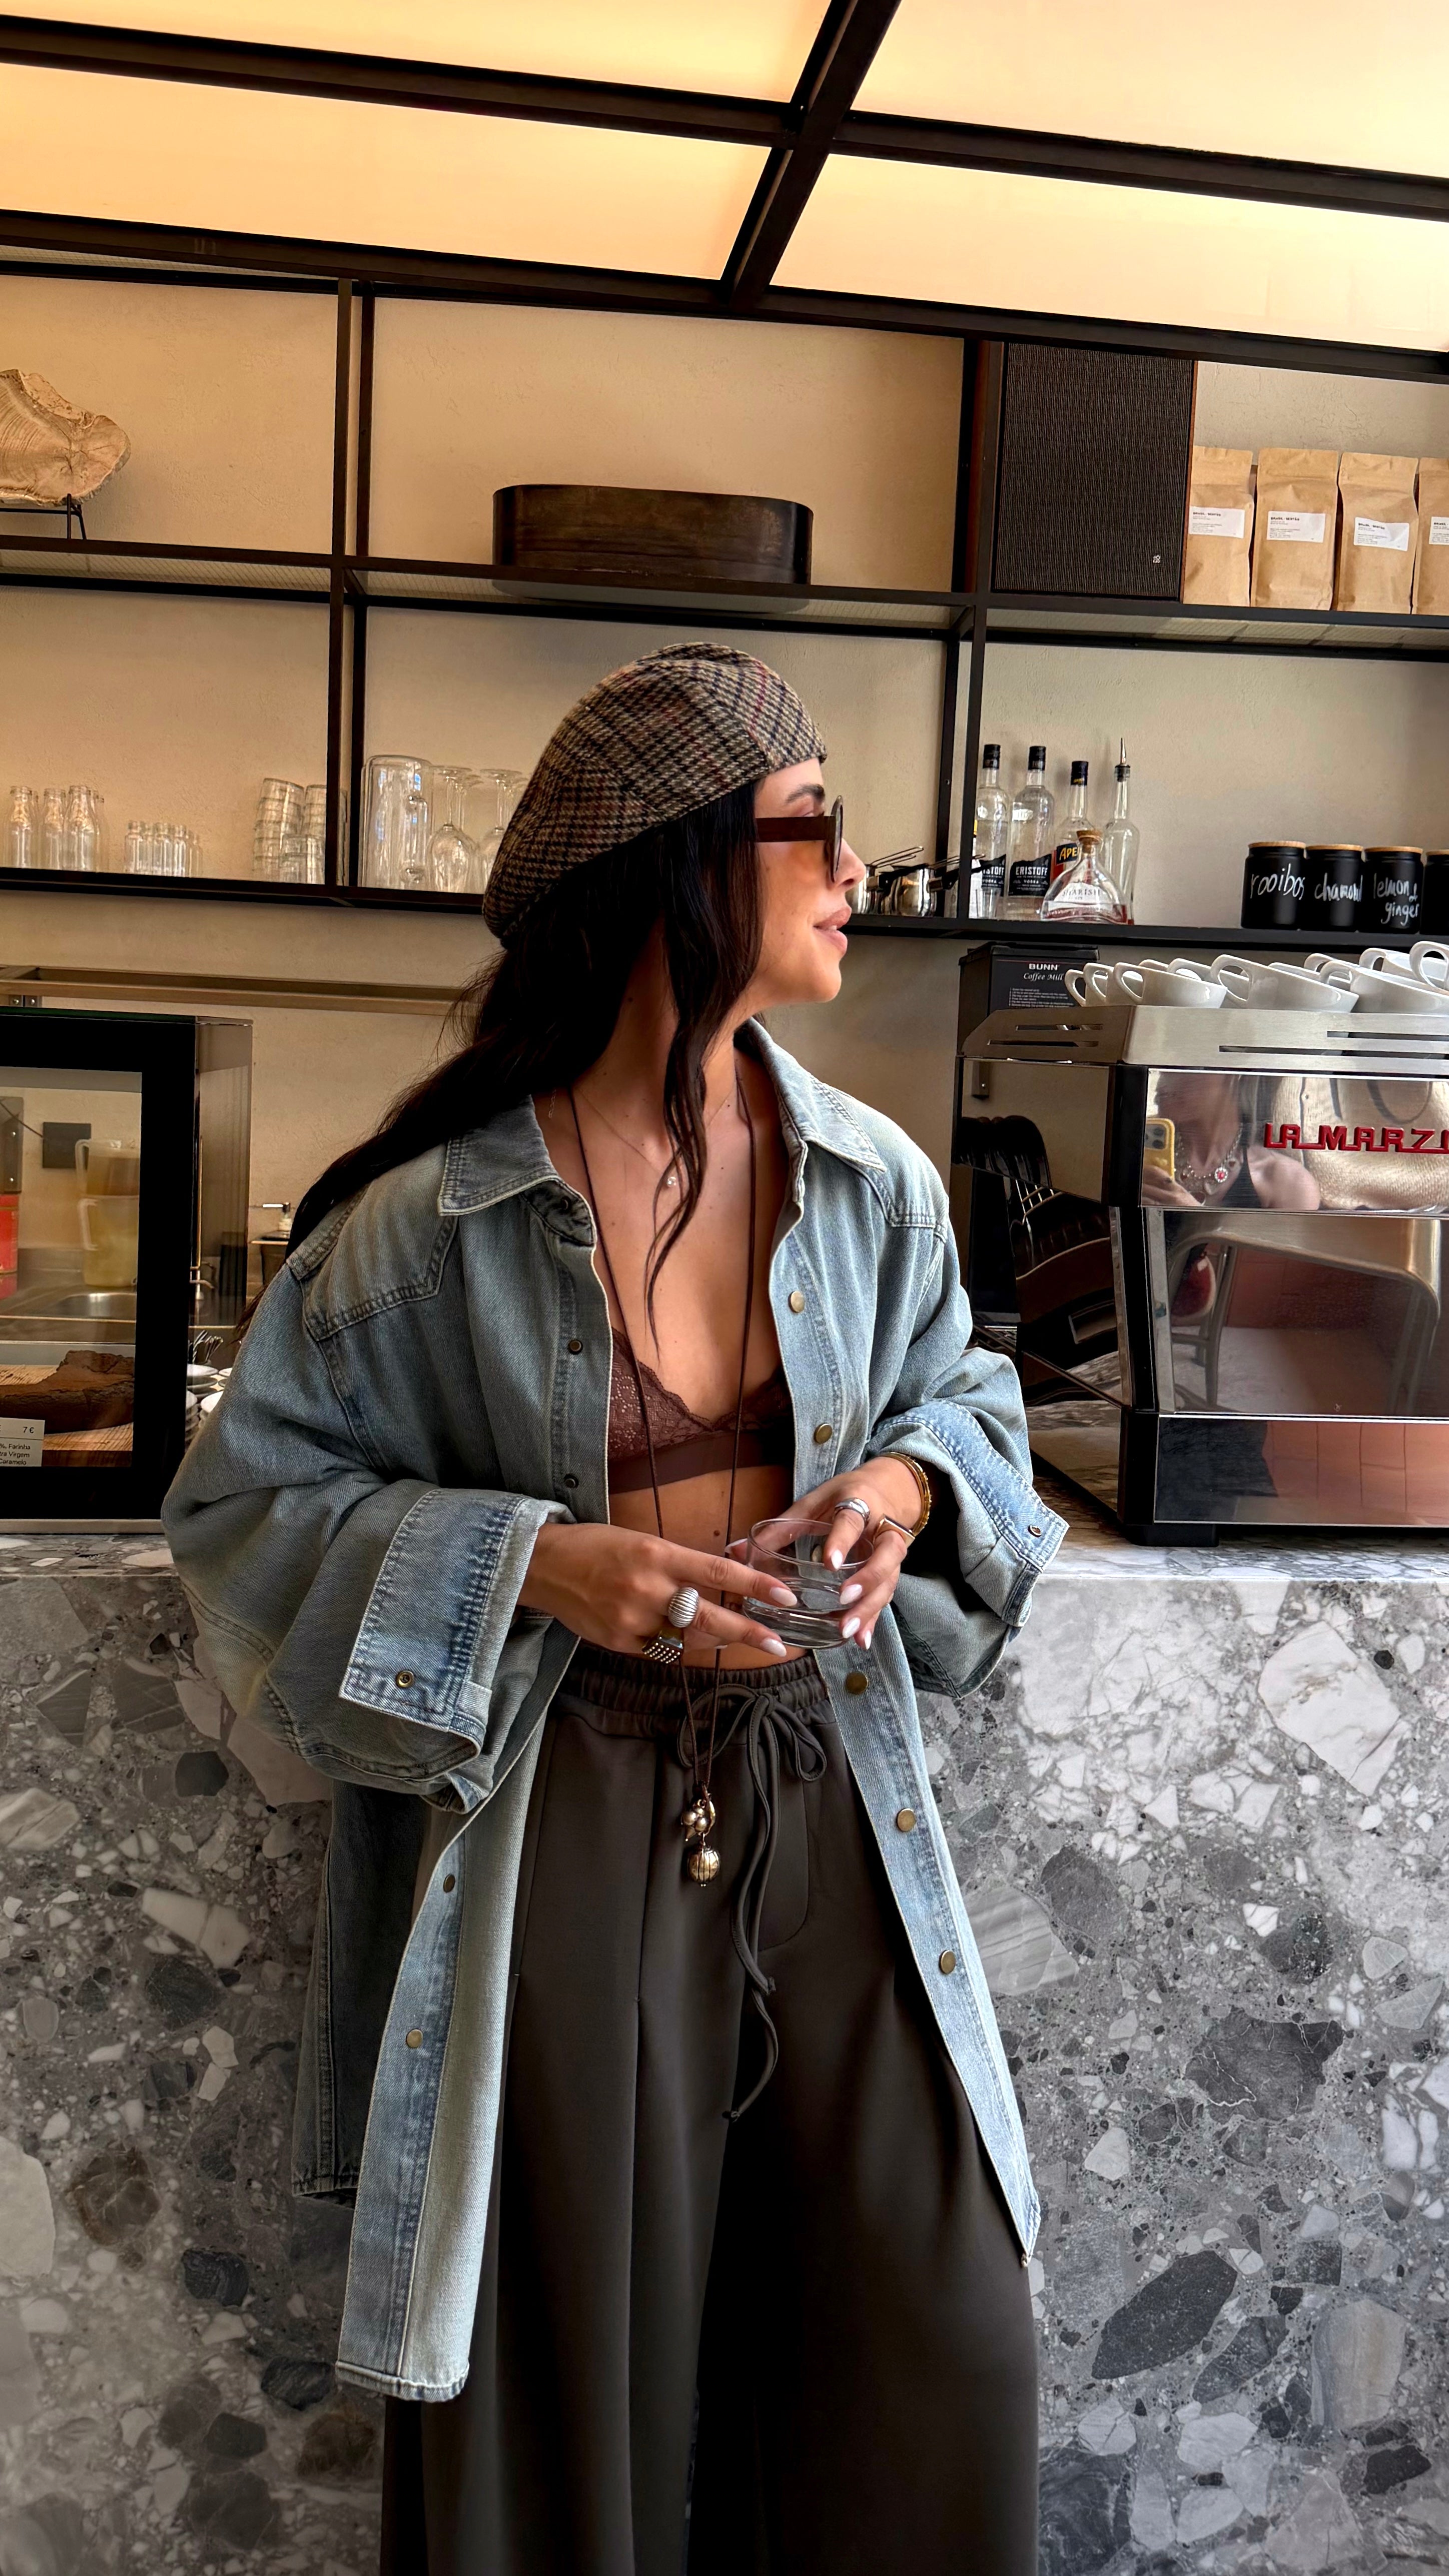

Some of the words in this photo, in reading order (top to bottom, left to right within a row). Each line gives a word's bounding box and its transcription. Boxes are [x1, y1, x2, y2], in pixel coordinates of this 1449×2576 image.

[1059, 847, 1078, 861] APE
[983, 866, 1005, 876] ISTOFF
[1015, 866, 1048, 876] ERISTOFF
[1250, 863, 1305, 900] rooibos
[1373, 873, 1409, 899] lemon
[1381, 902, 1420, 926] ginger
[1023, 972, 1045, 982] Coffee
[1047, 973, 1064, 981] Mill
[1263, 1122, 1300, 1149] LA
[9, 1451, 30, 1459] Virgem
